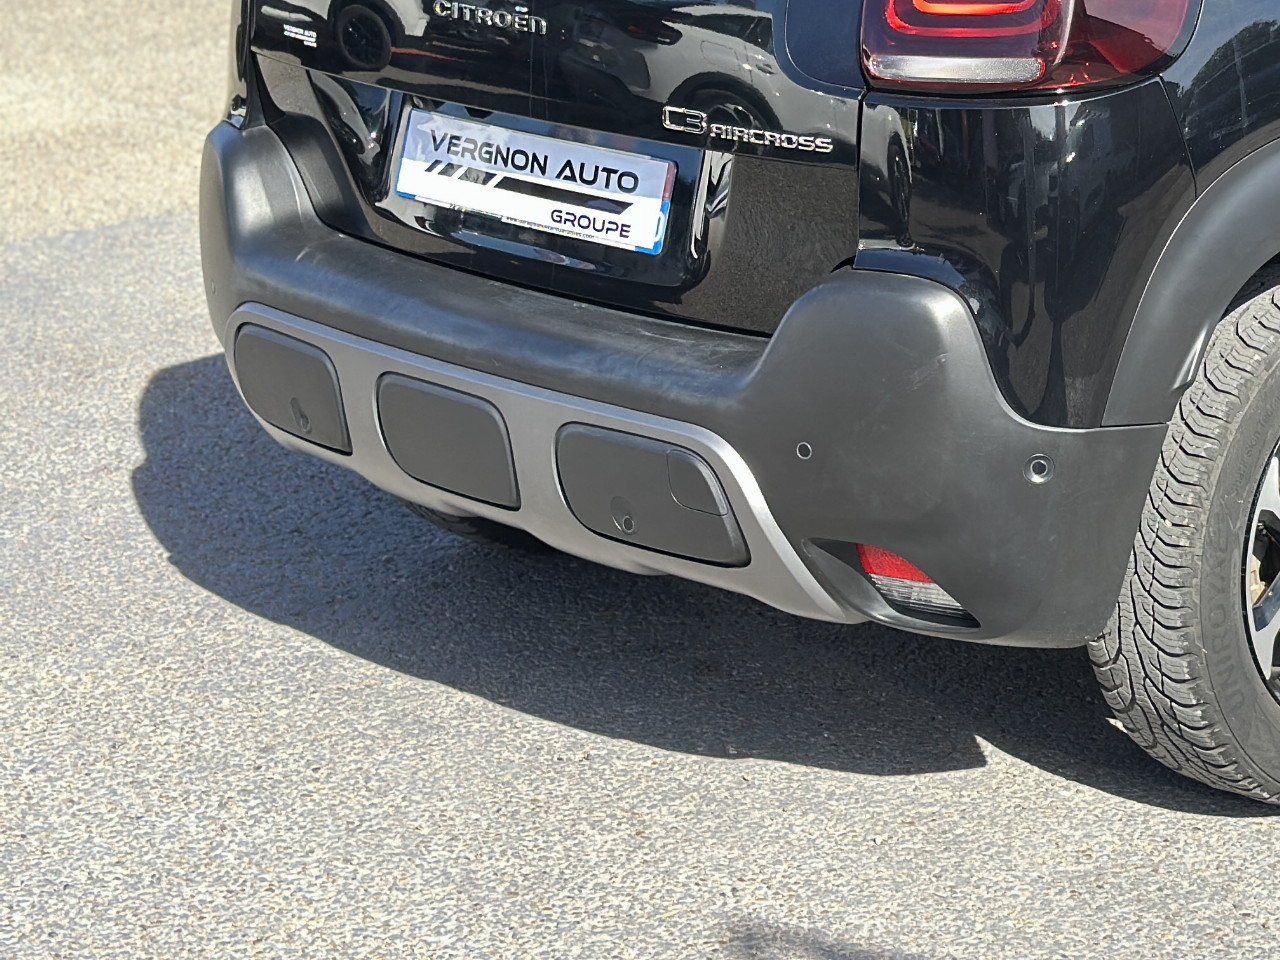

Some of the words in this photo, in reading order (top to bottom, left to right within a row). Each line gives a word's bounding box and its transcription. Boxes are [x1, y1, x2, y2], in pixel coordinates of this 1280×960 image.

[662, 105, 707, 135] C3
[710, 123, 834, 153] AIRCROSS
[430, 129, 548, 177] VERGNON
[556, 159, 639, 193] AUTO
[551, 209, 631, 238] GROUPE
